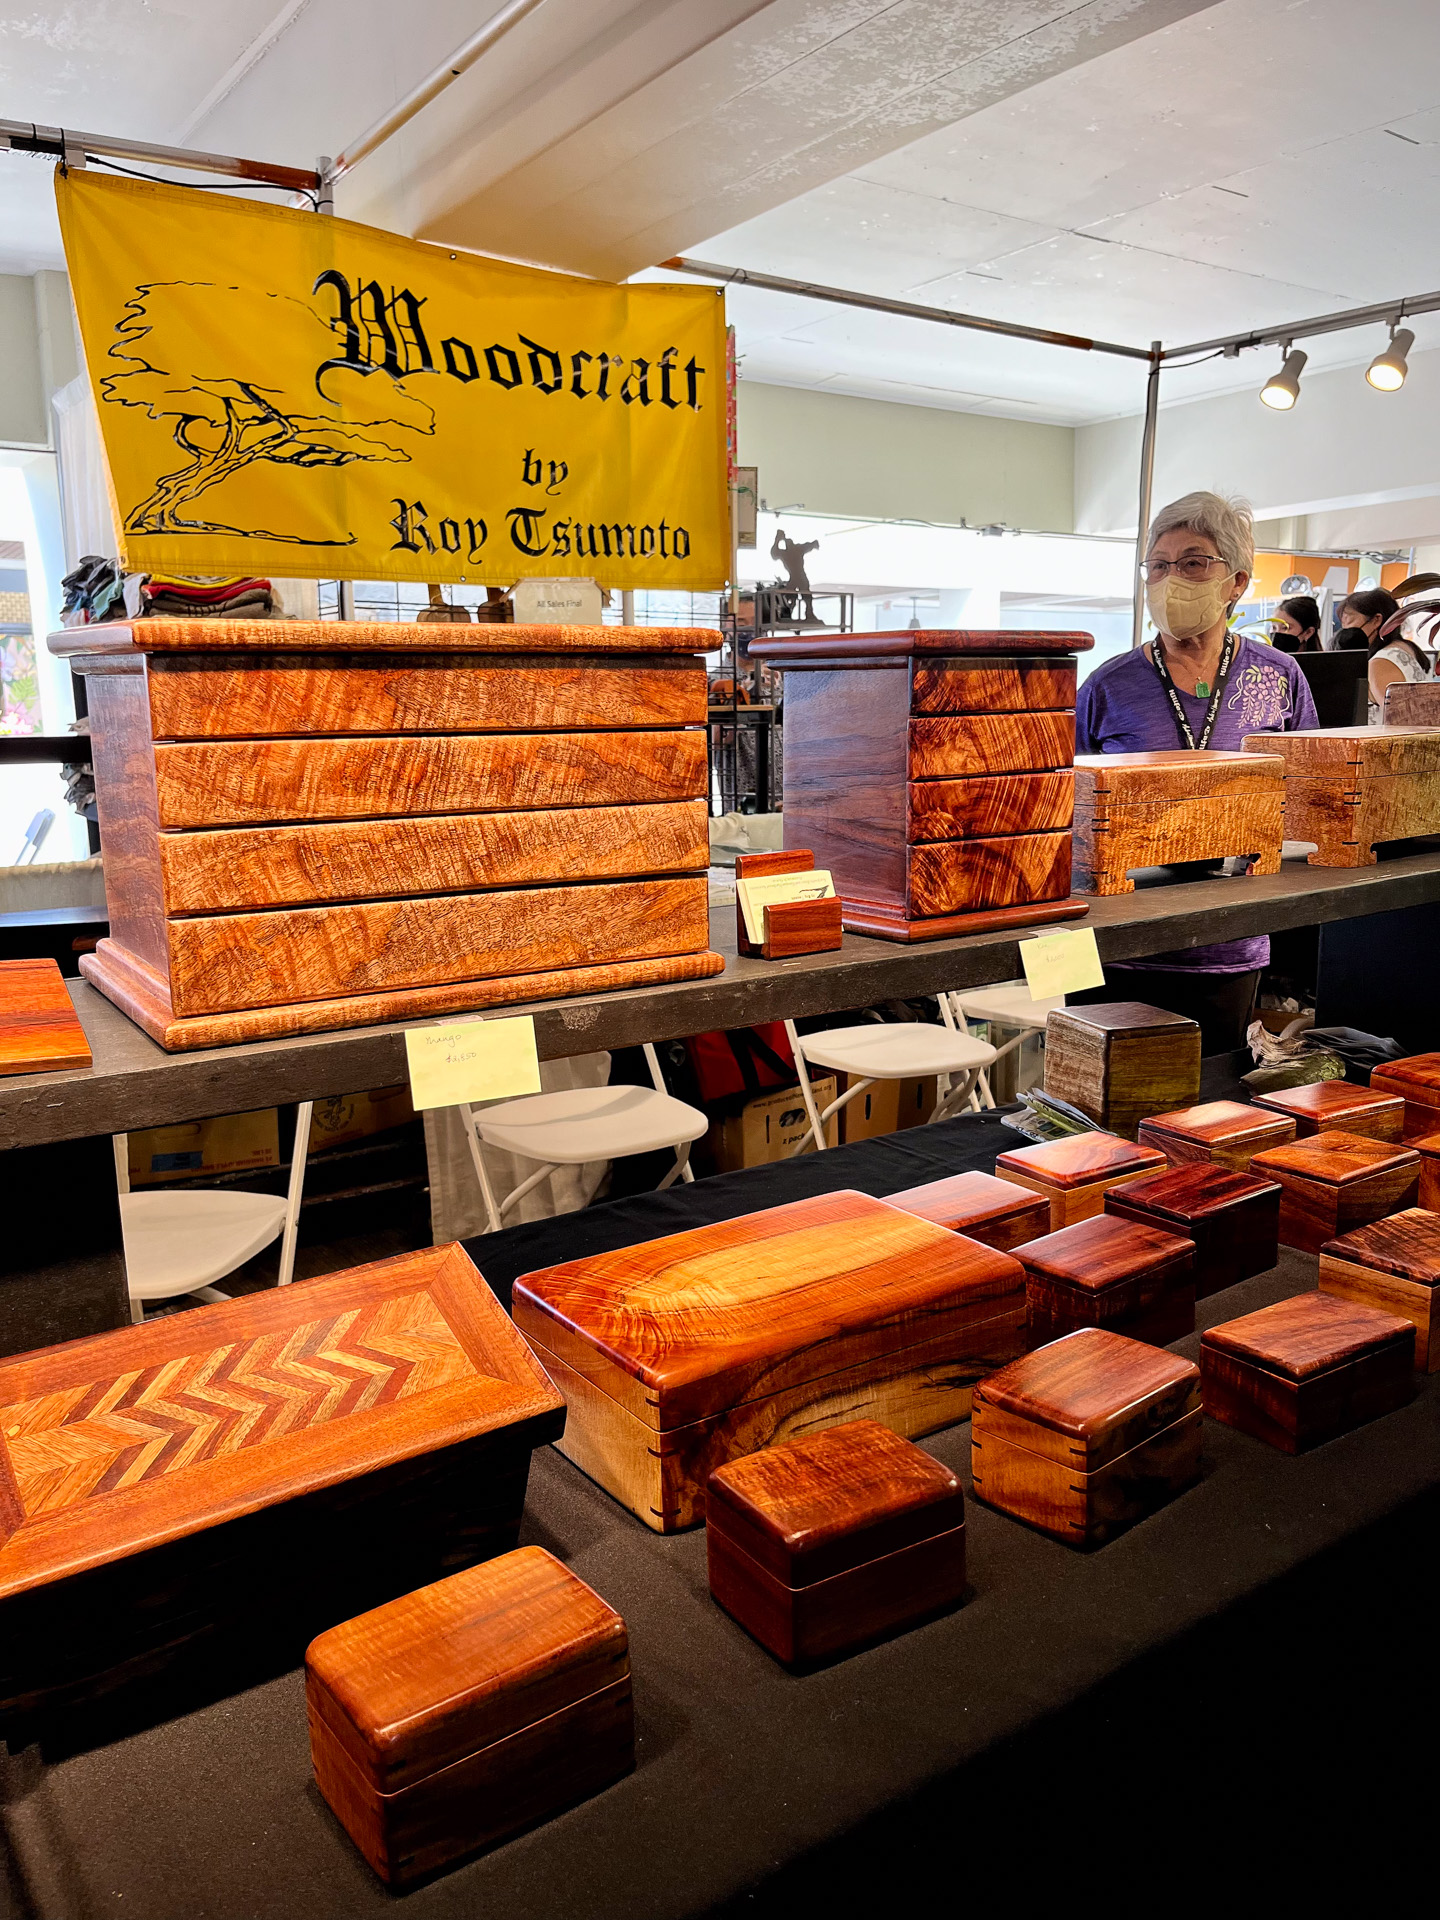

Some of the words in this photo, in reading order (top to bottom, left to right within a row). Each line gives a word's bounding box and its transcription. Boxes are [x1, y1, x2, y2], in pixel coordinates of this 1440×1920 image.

[312, 270, 706, 413] Woodcraft
[522, 448, 569, 496] by
[389, 498, 488, 565] Roy
[505, 507, 691, 560] Tsumoto
[547, 600, 565, 608] Sales
[566, 599, 582, 608] Final
